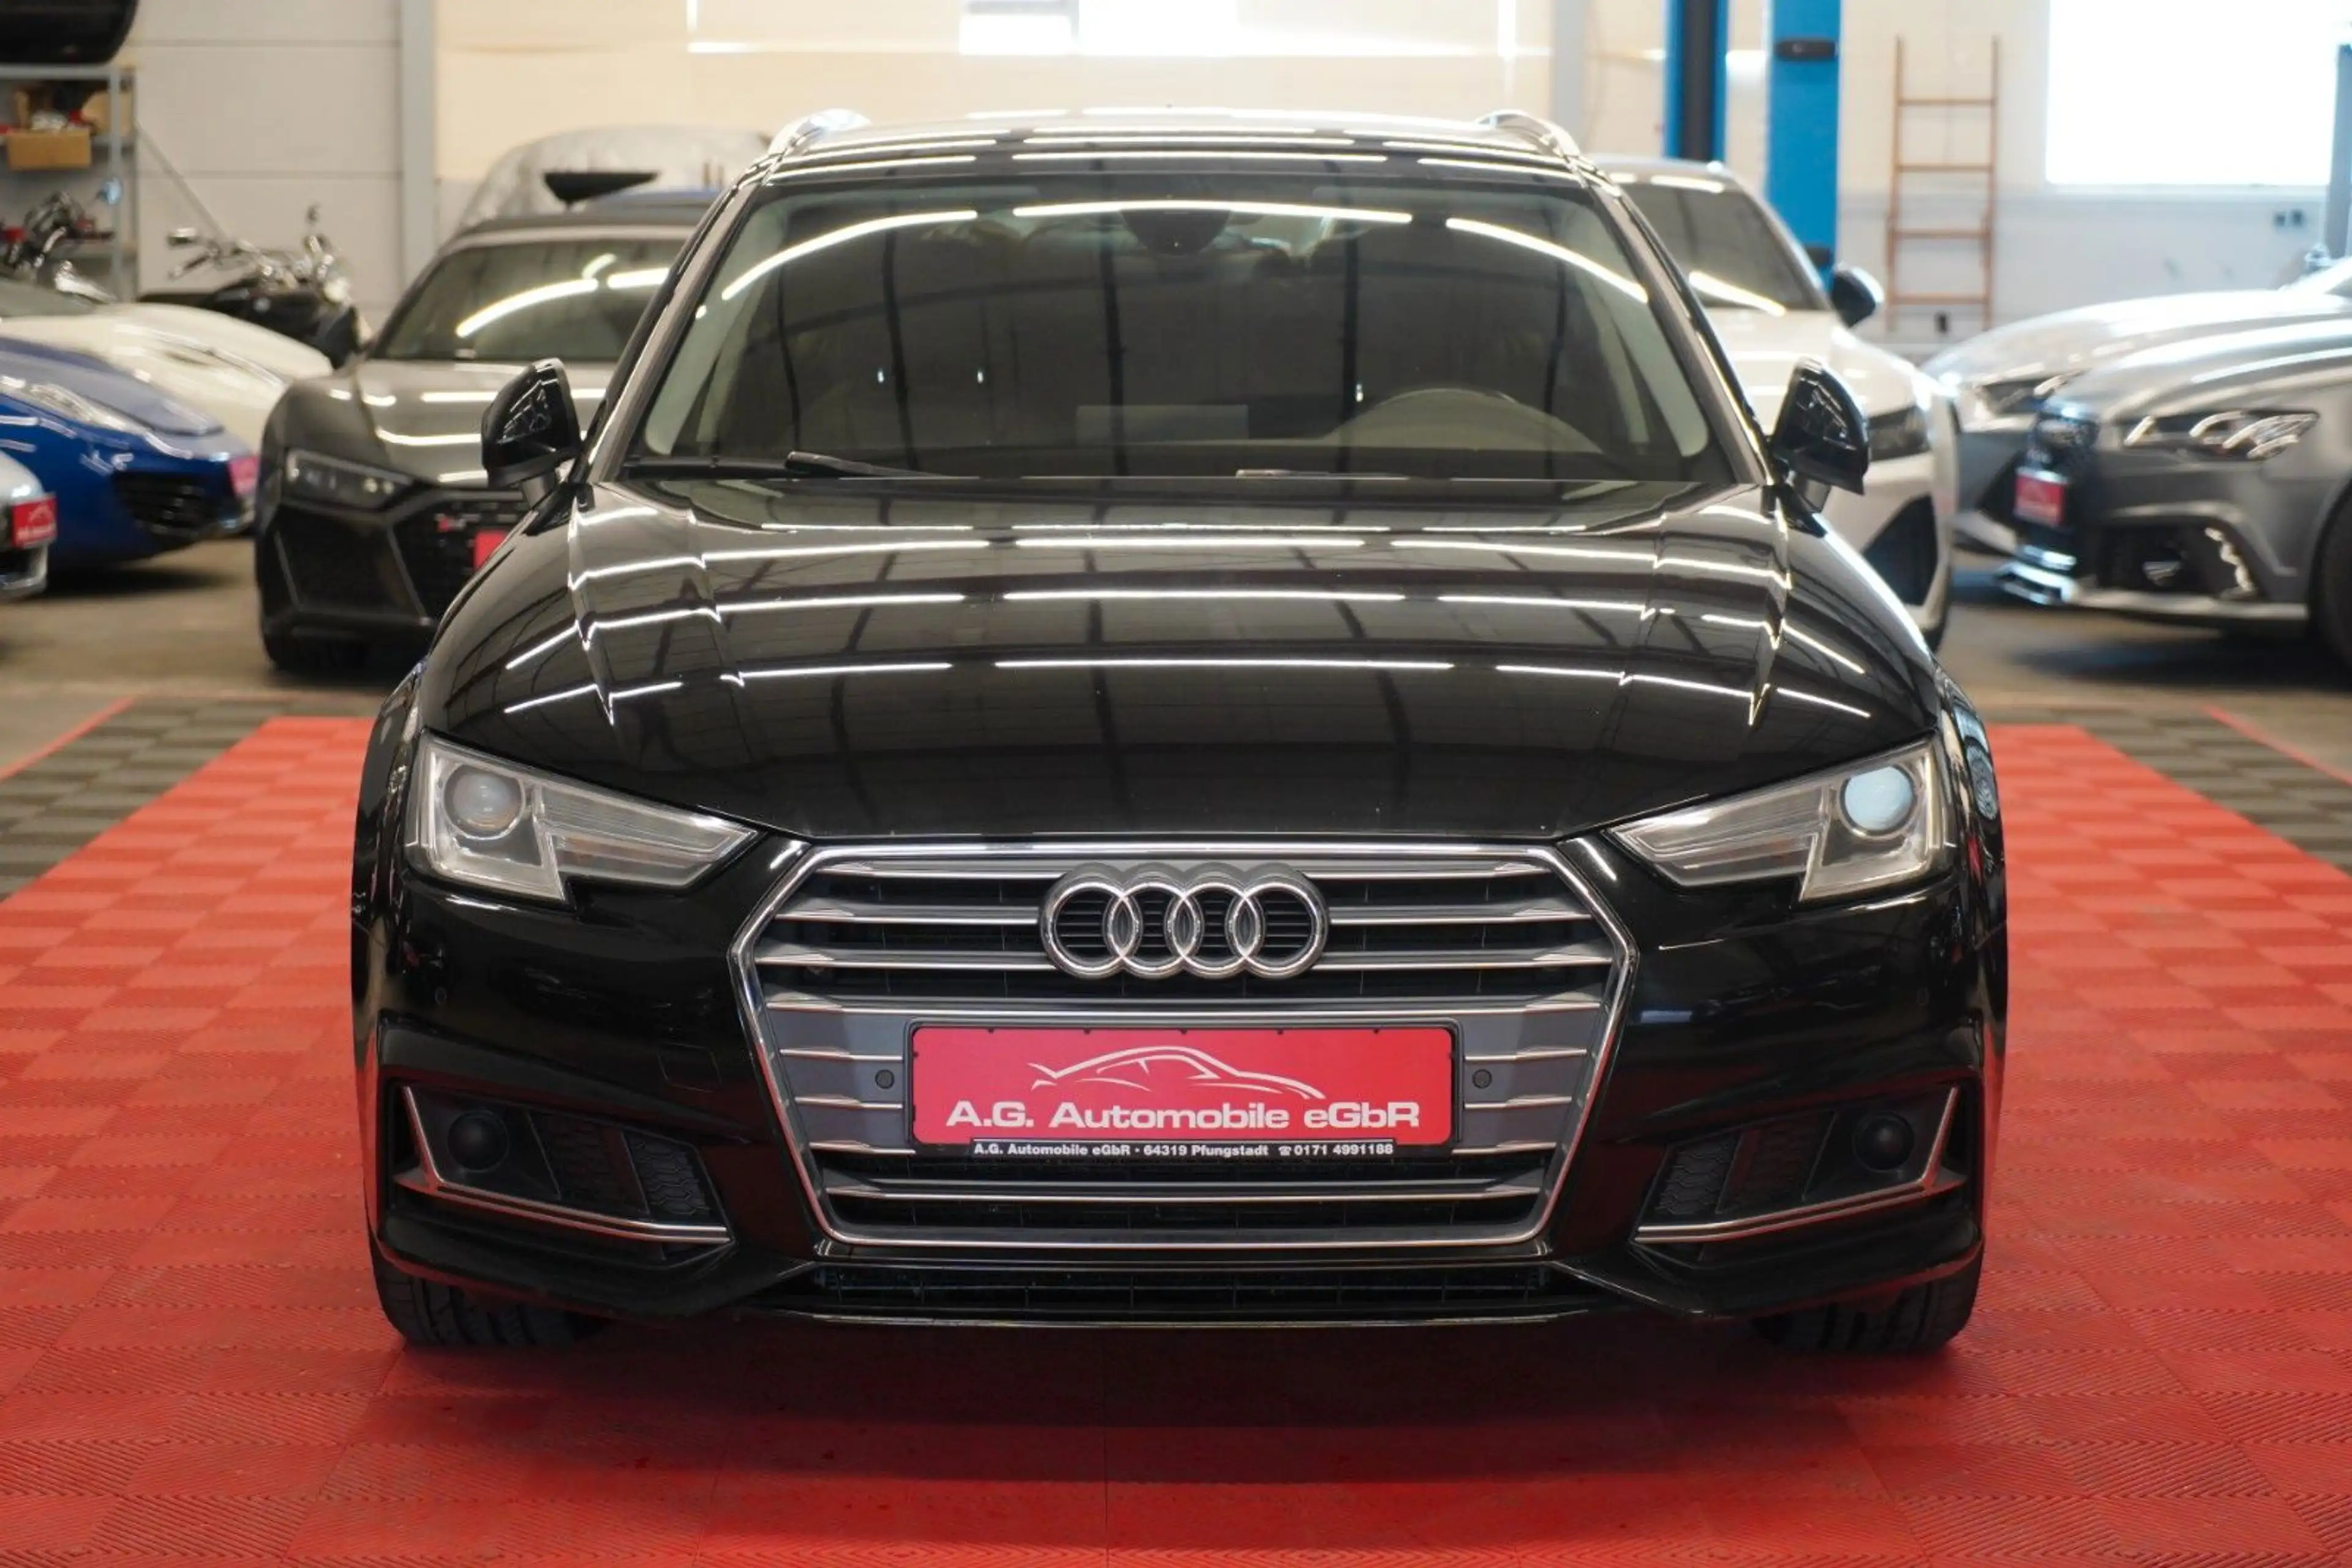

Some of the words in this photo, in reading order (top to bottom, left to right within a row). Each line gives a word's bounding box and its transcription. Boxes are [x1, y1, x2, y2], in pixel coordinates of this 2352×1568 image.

[946, 1100, 1035, 1128] A.G.
[1048, 1101, 1291, 1129] Automobile
[1303, 1101, 1420, 1129] eGbR
[973, 1143, 1004, 1155] A.G.
[1007, 1143, 1088, 1156] Automobile
[1091, 1143, 1131, 1156] eGbR
[1143, 1144, 1188, 1156] 64319
[1191, 1144, 1269, 1158] Pfungstadt
[1294, 1144, 1327, 1156] 0171
[1332, 1144, 1394, 1155] 4991188
